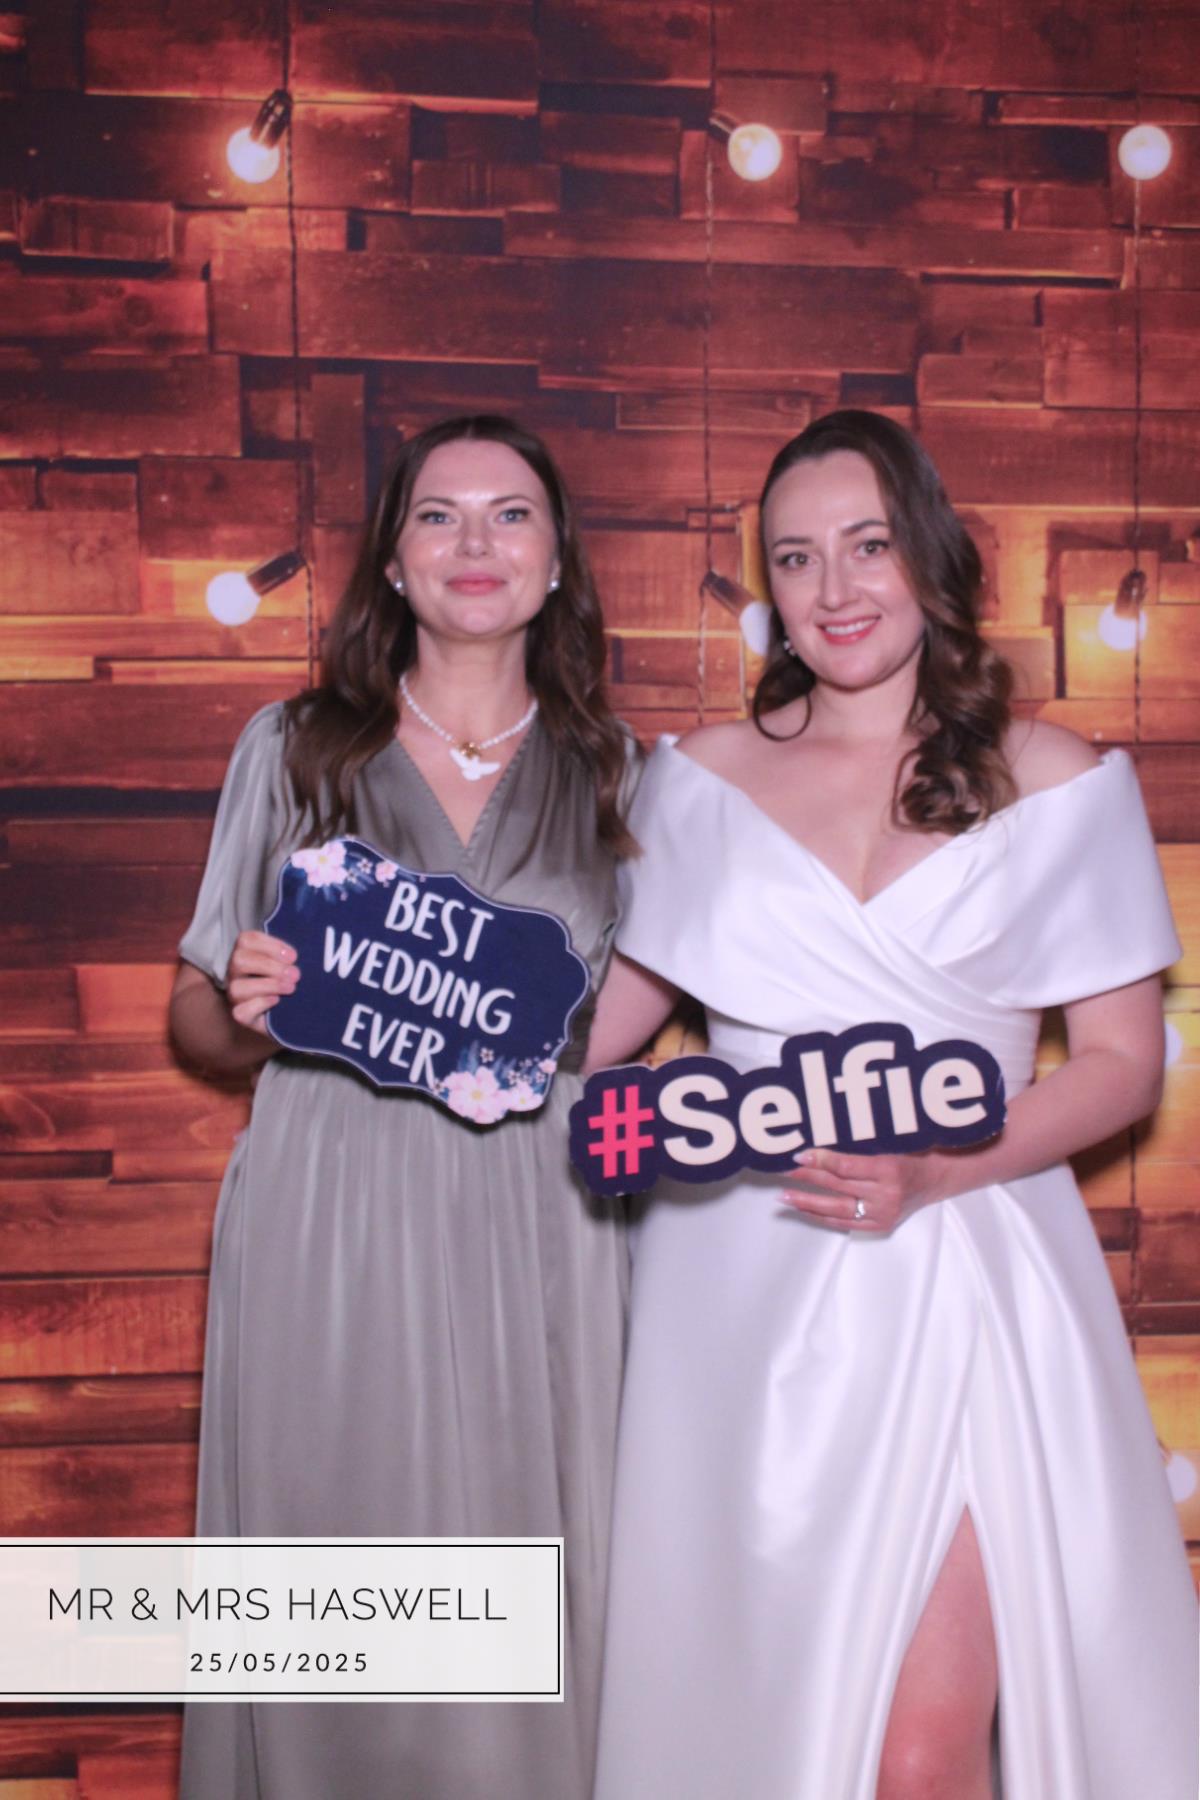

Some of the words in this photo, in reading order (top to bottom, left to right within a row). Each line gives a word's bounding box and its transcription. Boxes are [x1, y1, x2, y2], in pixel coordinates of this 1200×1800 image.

[384, 881, 495, 962] BEST
[323, 926, 516, 1035] WEDDING
[341, 1003, 446, 1088] EVER
[588, 1041, 987, 1179] #Selfie
